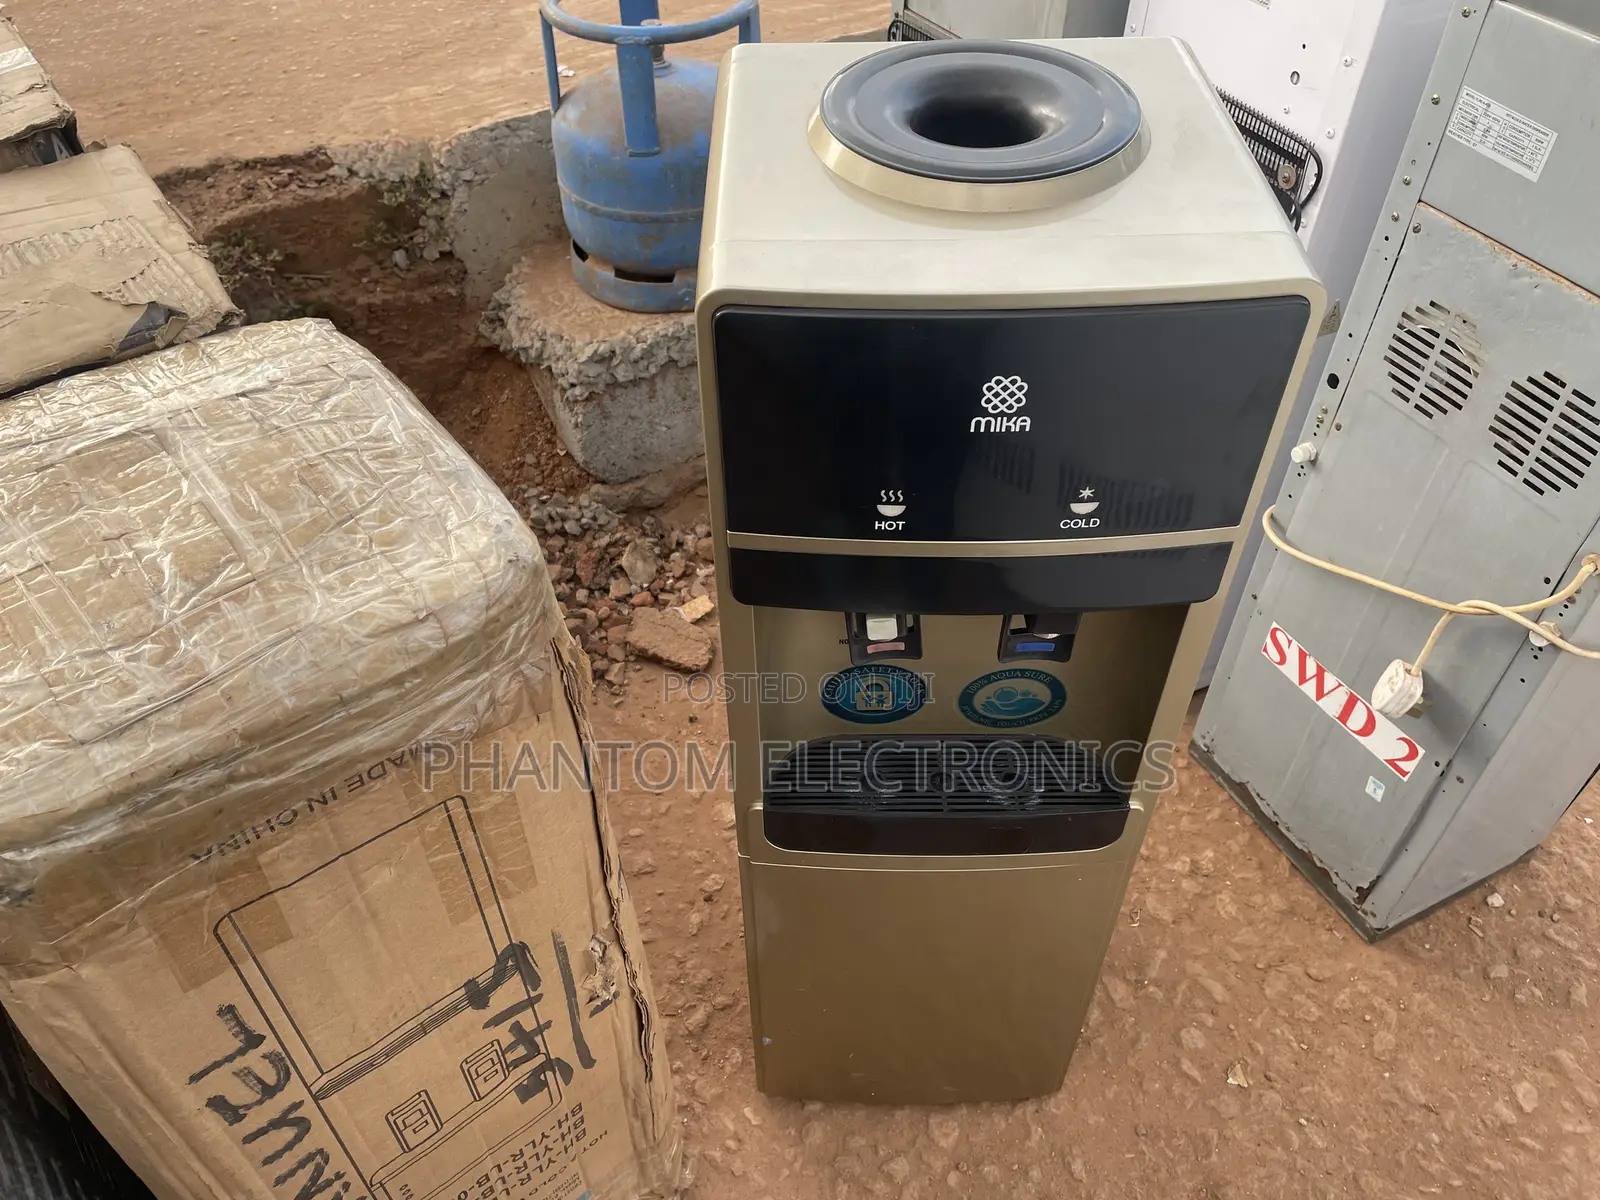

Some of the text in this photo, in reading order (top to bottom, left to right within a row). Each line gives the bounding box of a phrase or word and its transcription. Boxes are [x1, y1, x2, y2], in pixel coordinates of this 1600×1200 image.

[970, 416, 1031, 432] MIKA
[874, 520, 906, 531] HOT
[1060, 518, 1100, 529] COLD
[854, 666, 902, 677] SAFETY
[966, 670, 1052, 694] 100% AQUA SURE
[1262, 627, 1419, 778] SWD 2
[190, 742, 428, 862] MADE IN CHINA
[452, 1102, 582, 1200] BH-YLR-LB-0
[581, 1130, 608, 1155] HOT
[528, 1166, 567, 1196] COLD
